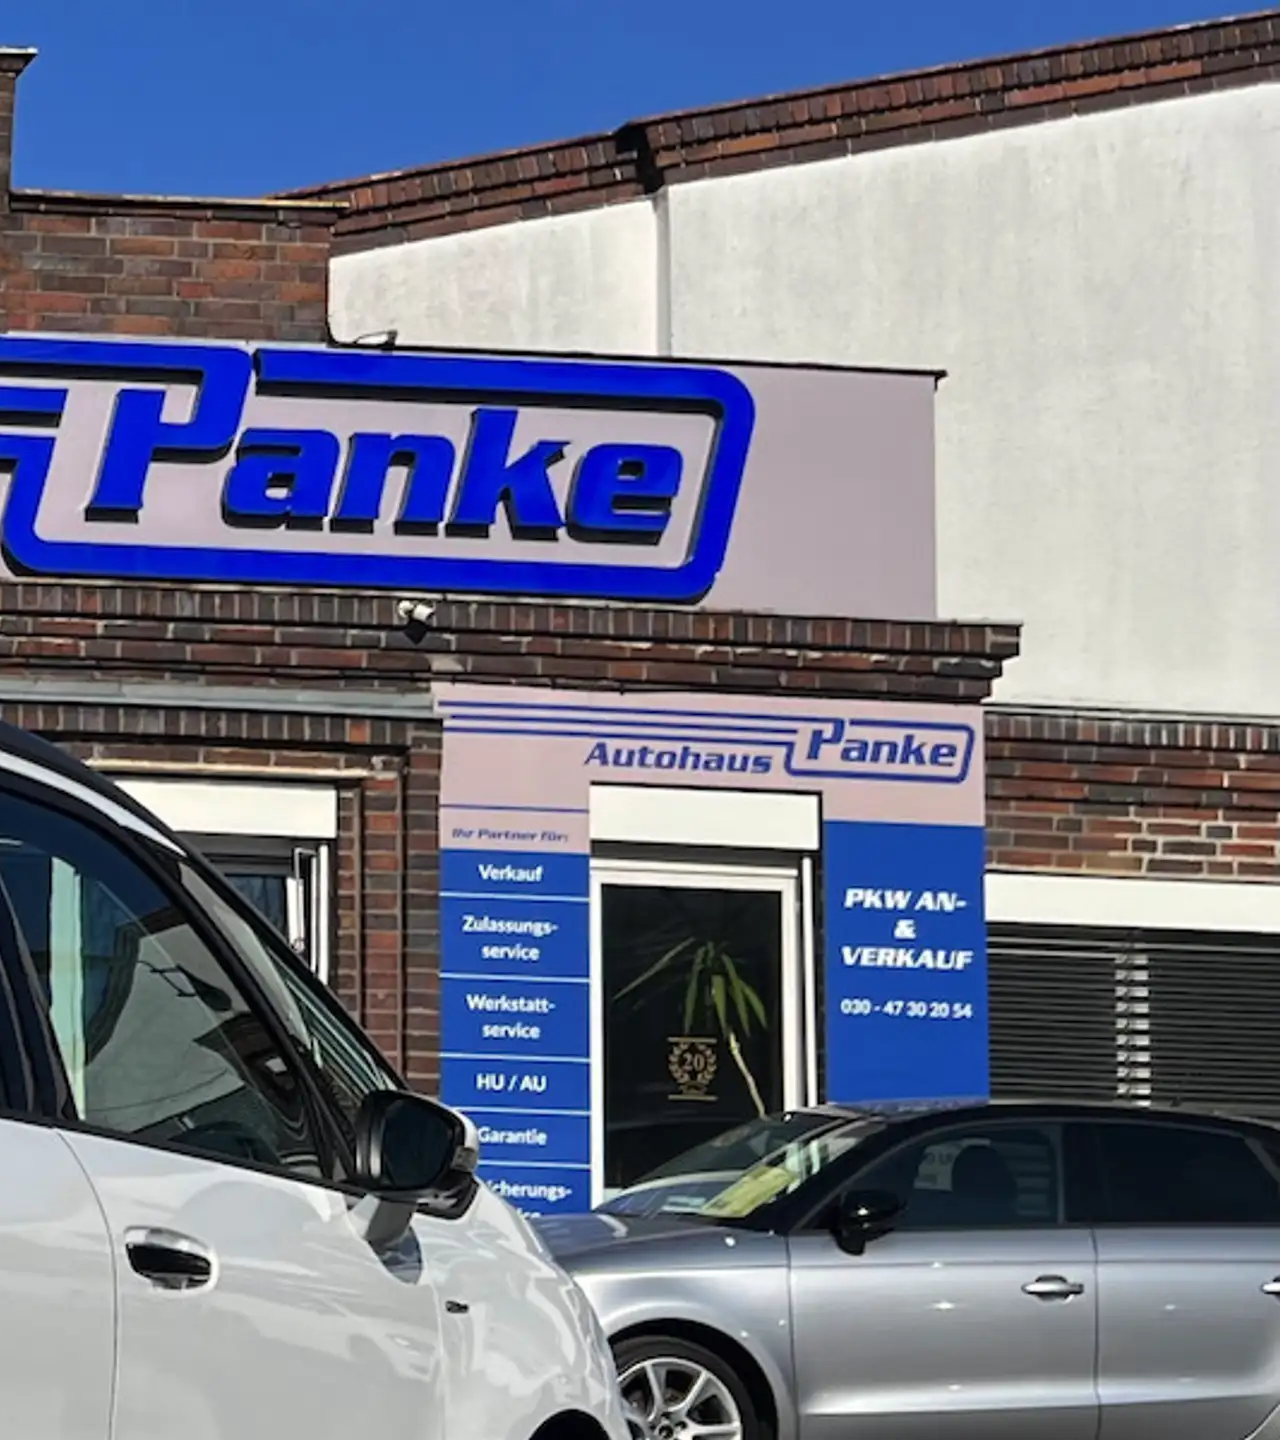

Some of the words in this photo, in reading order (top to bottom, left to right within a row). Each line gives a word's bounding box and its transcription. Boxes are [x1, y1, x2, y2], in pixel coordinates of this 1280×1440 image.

[84, 346, 683, 546] Panke
[584, 741, 772, 774] Autohaus
[805, 717, 958, 767] Panke
[478, 828, 536, 841] Partner
[478, 863, 543, 882] Verkauf
[844, 887, 912, 910] PKW
[914, 890, 968, 912] AN-
[462, 915, 558, 937] Zulassungs-
[894, 918, 917, 939] &
[481, 943, 540, 960] service
[841, 945, 974, 970] VERKAUF
[466, 994, 556, 1014] Werkstatt-
[840, 998, 872, 1016] 030
[882, 1000, 904, 1016] 47
[906, 1001, 927, 1017] 30
[929, 1002, 950, 1018] 20
[952, 1003, 973, 1019] 54
[482, 1021, 541, 1039] service
[682, 1052, 705, 1072] 20
[476, 1073, 505, 1091] HU
[508, 1075, 519, 1092] /
[520, 1075, 547, 1092] AU
[478, 1127, 548, 1145] Garantie
